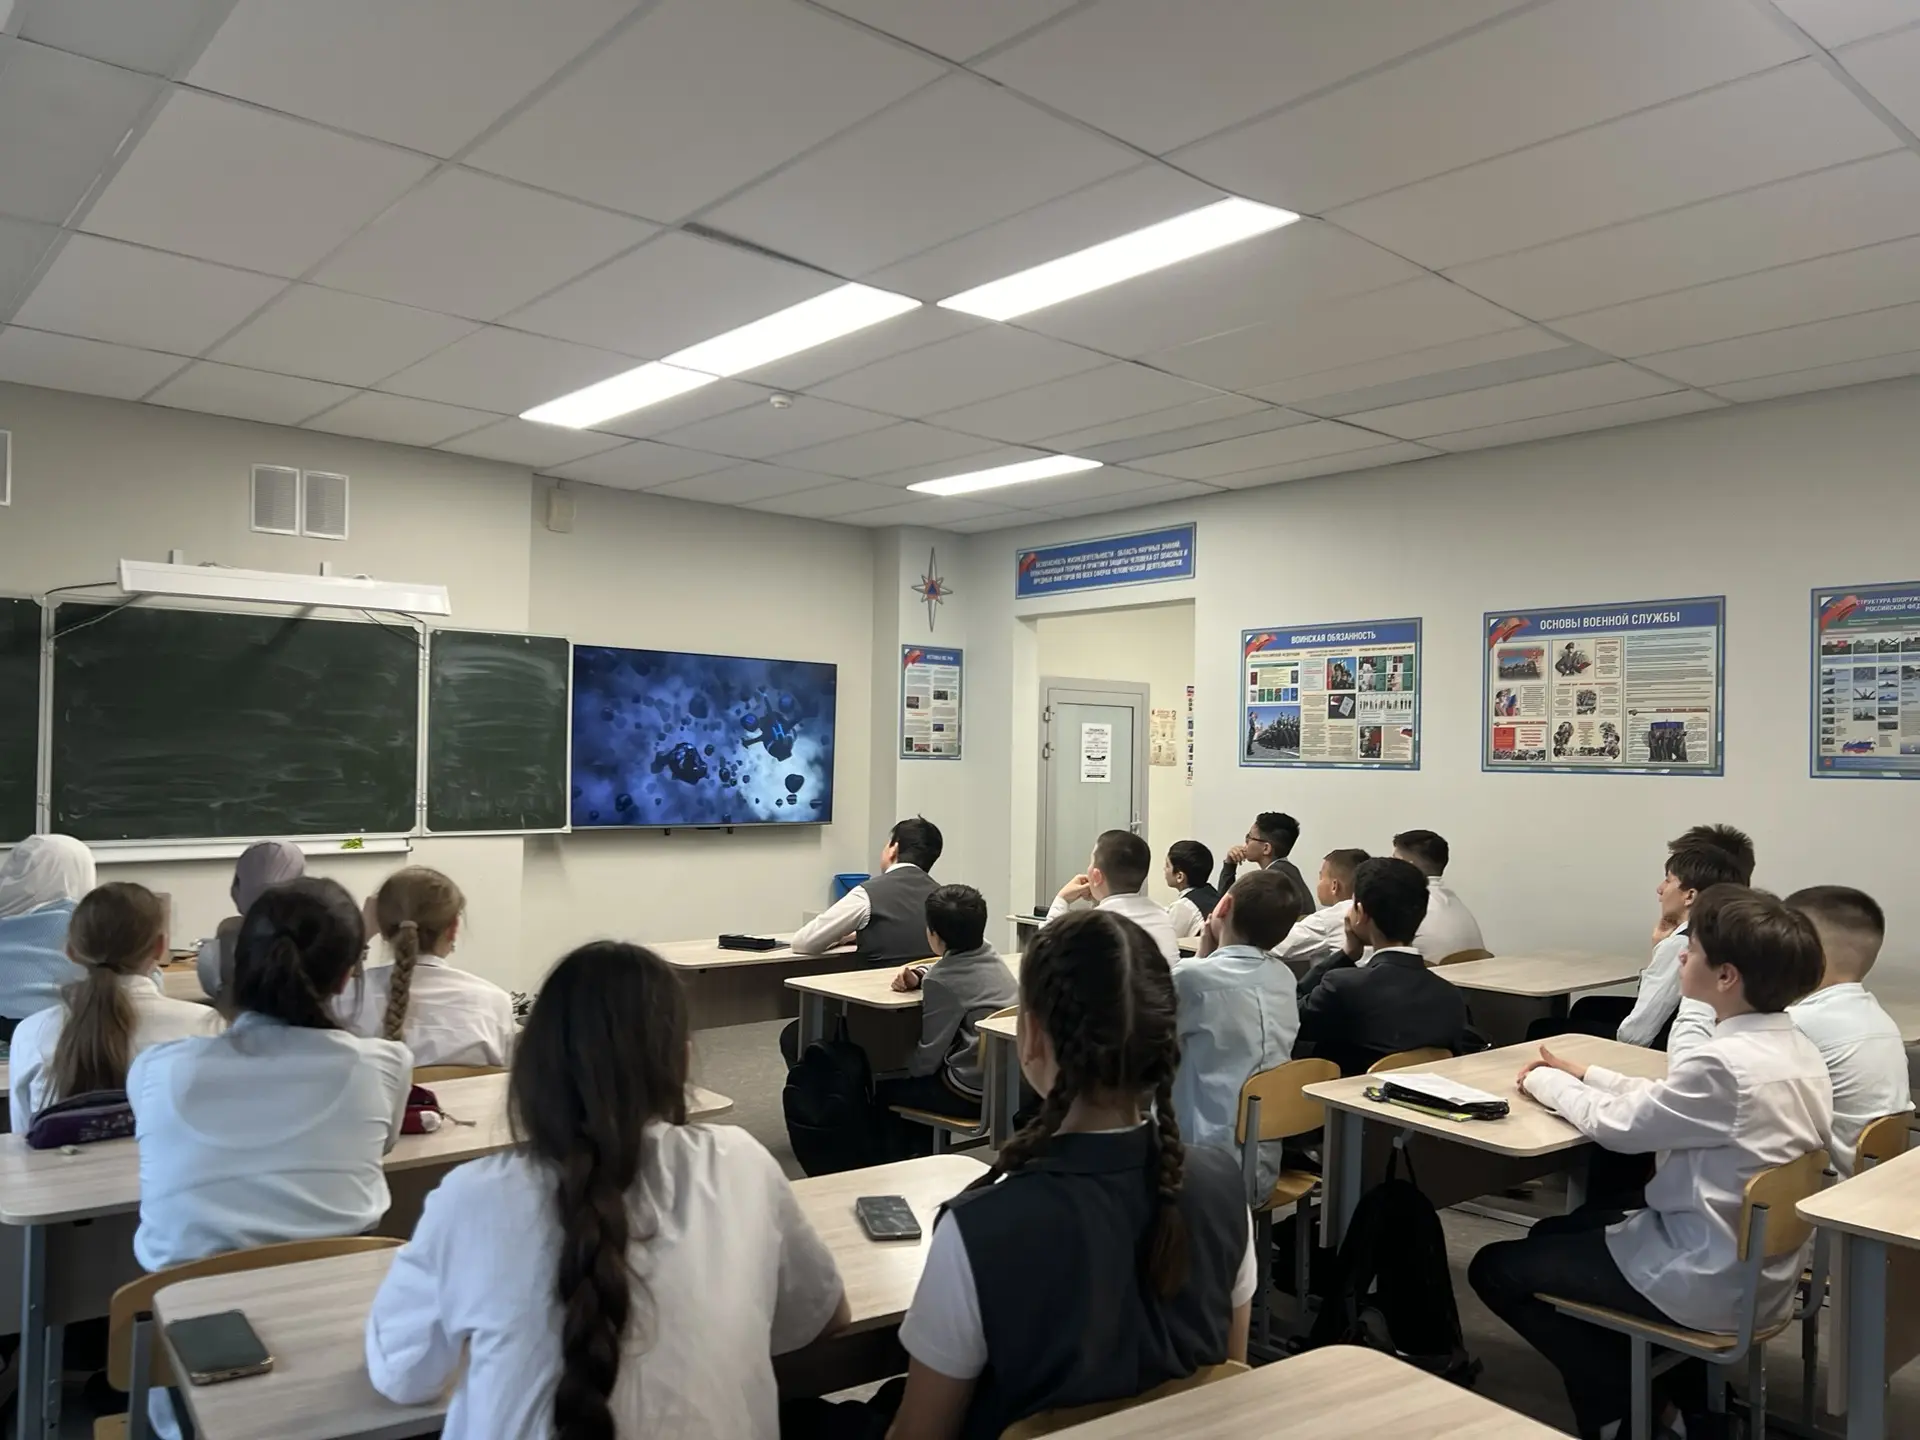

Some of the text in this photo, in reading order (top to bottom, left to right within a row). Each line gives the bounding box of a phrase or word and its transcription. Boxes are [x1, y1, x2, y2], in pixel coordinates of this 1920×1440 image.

[1540, 611, 1680, 630] ОСНОВЫ ВОЕННОЙ СЛУЖБЫ
[1291, 630, 1377, 645] ВОИНСКАЯ ОБЯЗАННОСТЬ
